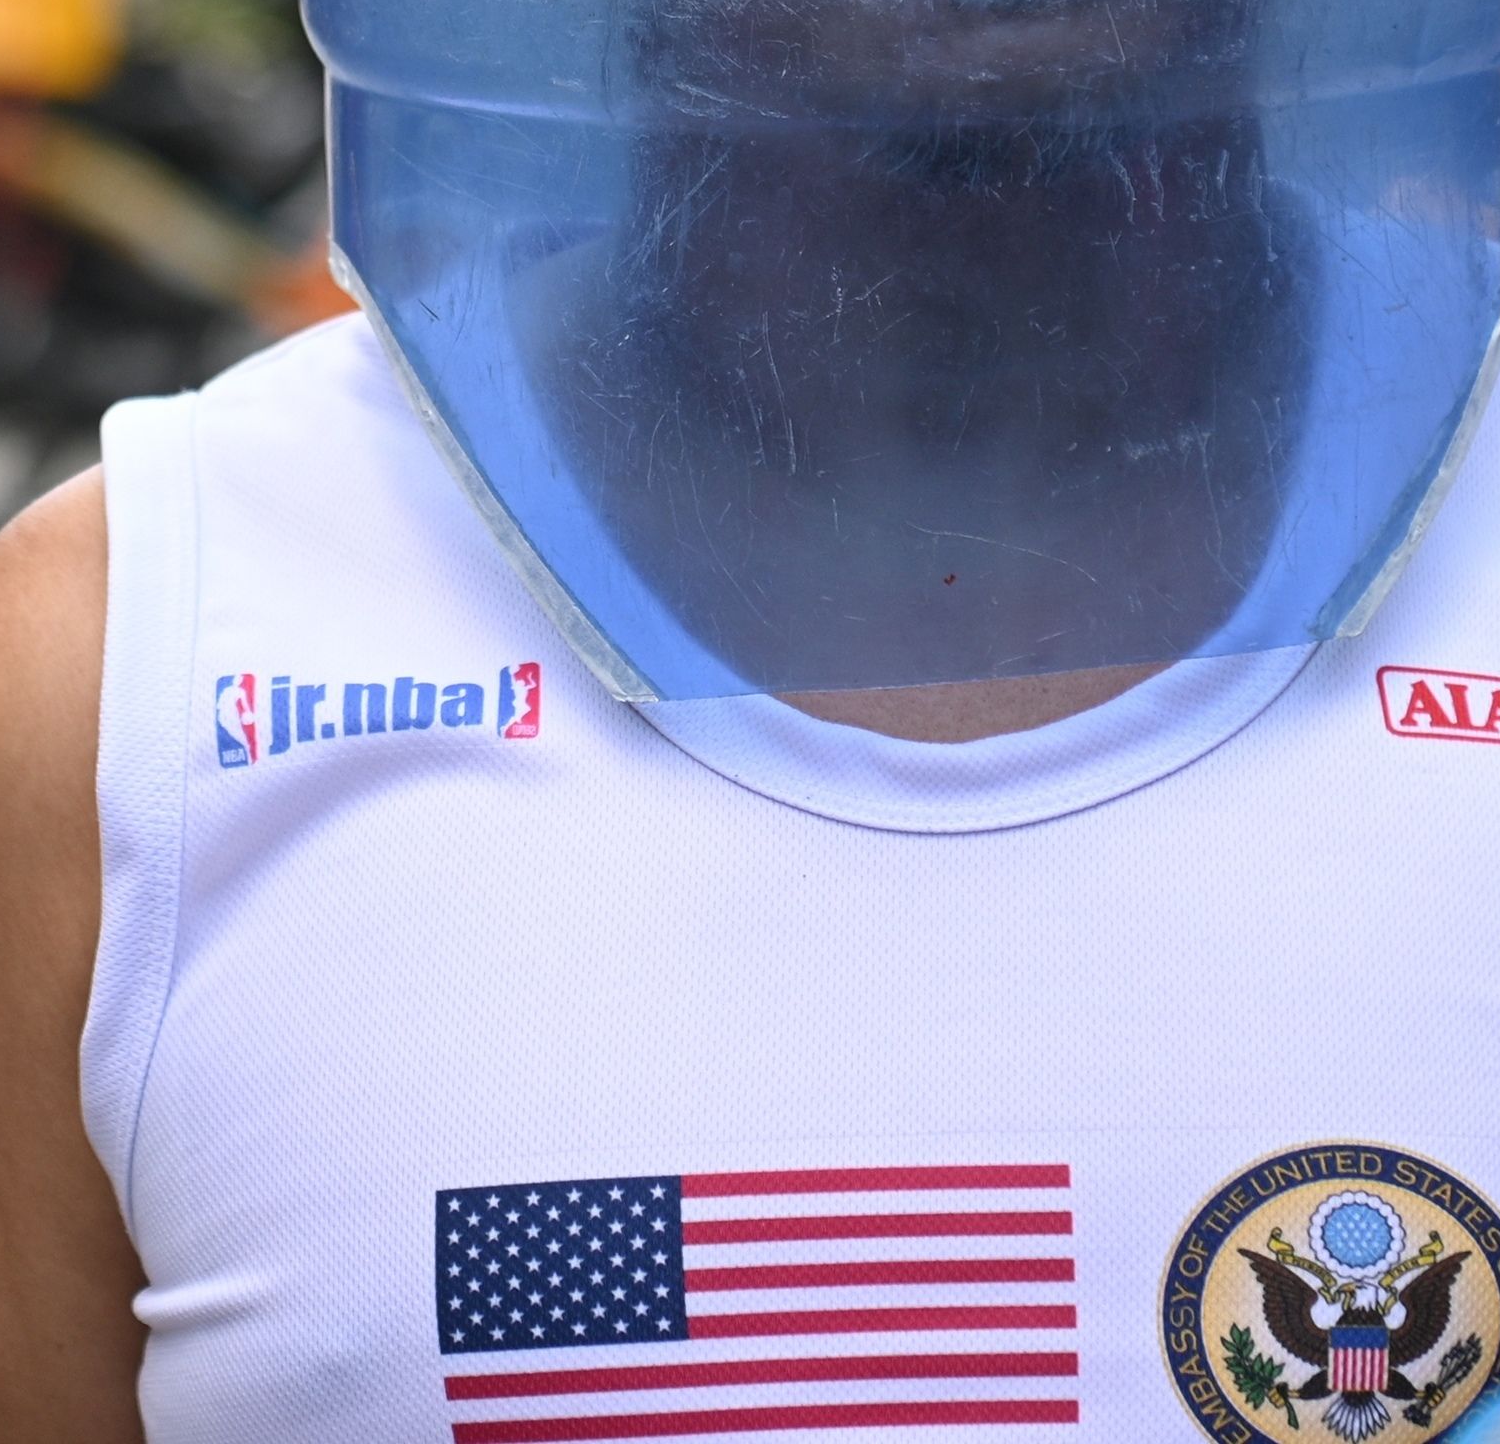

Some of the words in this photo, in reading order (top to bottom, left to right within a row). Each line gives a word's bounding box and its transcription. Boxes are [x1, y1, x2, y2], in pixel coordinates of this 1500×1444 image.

[269, 675, 485, 756] jr.nba
[1250, 1150, 1382, 1196] UNITED
[1202, 1186, 1254, 1233] THE
[1179, 1232, 1209, 1278] OF
[1169, 1282, 1252, 1444] EMBASSY
